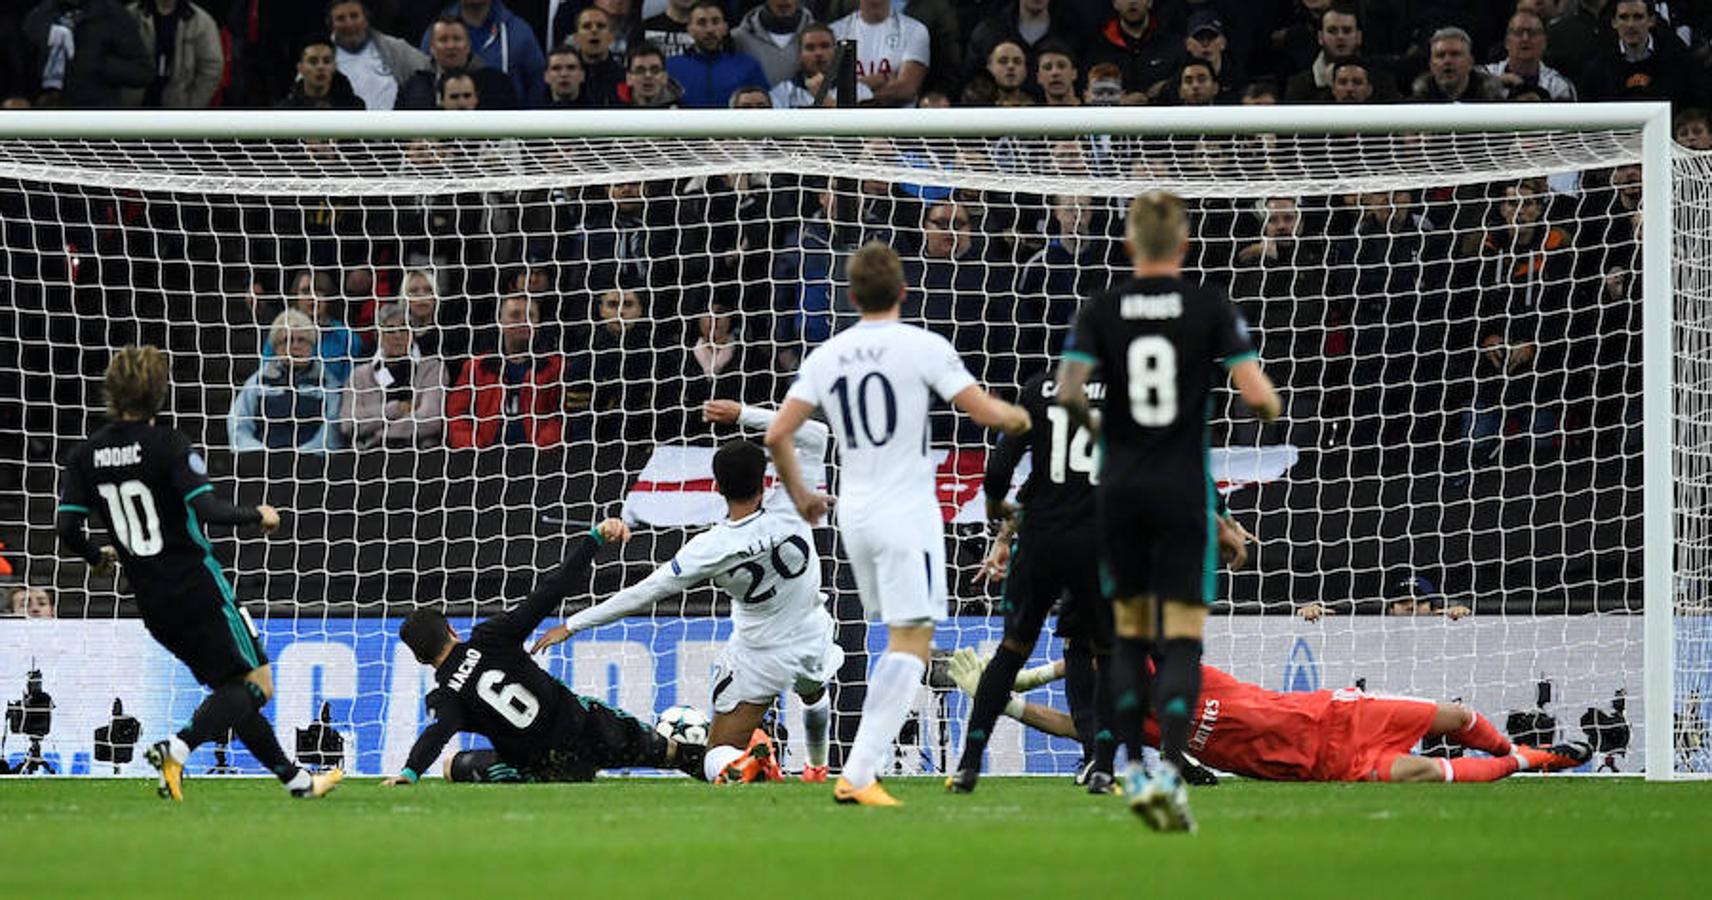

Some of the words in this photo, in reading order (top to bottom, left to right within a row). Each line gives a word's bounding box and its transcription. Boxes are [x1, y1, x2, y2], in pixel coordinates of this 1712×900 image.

[829, 371, 897, 449] 10
[1127, 334, 1178, 427] 8
[1046, 405, 1101, 485] 14
[97, 479, 164, 557] 10
[725, 534, 810, 604] 20
[446, 647, 482, 693] NACHO
[476, 669, 540, 729] 6
